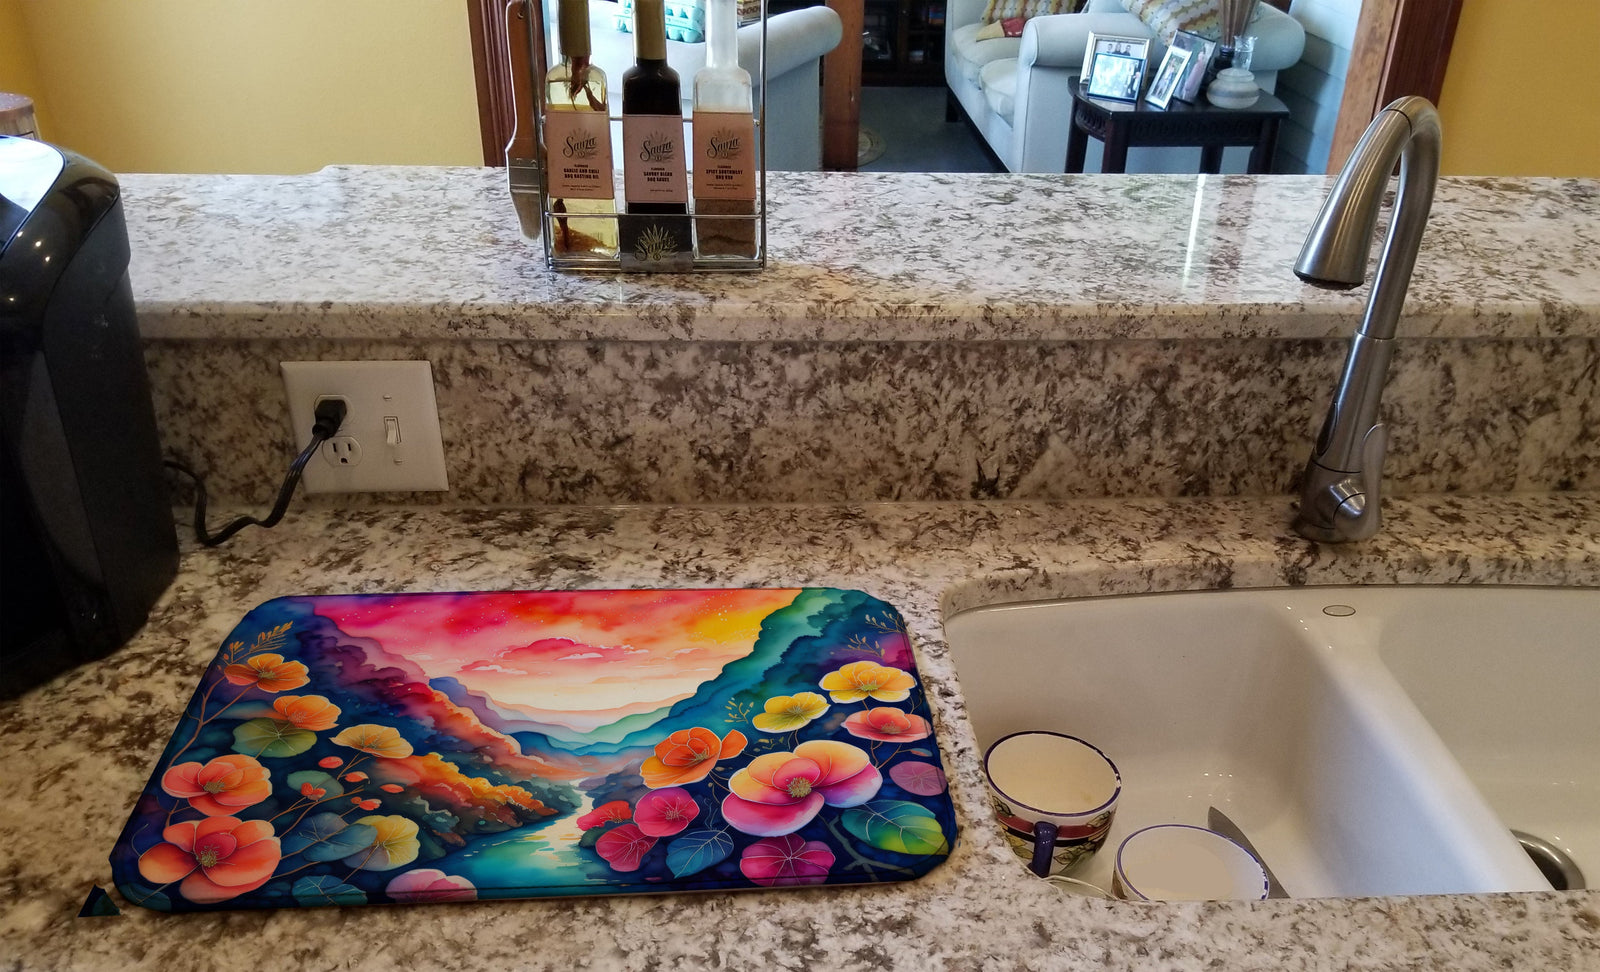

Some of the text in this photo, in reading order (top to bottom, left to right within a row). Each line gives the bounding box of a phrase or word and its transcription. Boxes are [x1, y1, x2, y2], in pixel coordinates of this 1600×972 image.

[563, 136, 597, 158] Sauza
[640, 140, 674, 162] Sauza
[707, 137, 740, 159] Sauza
